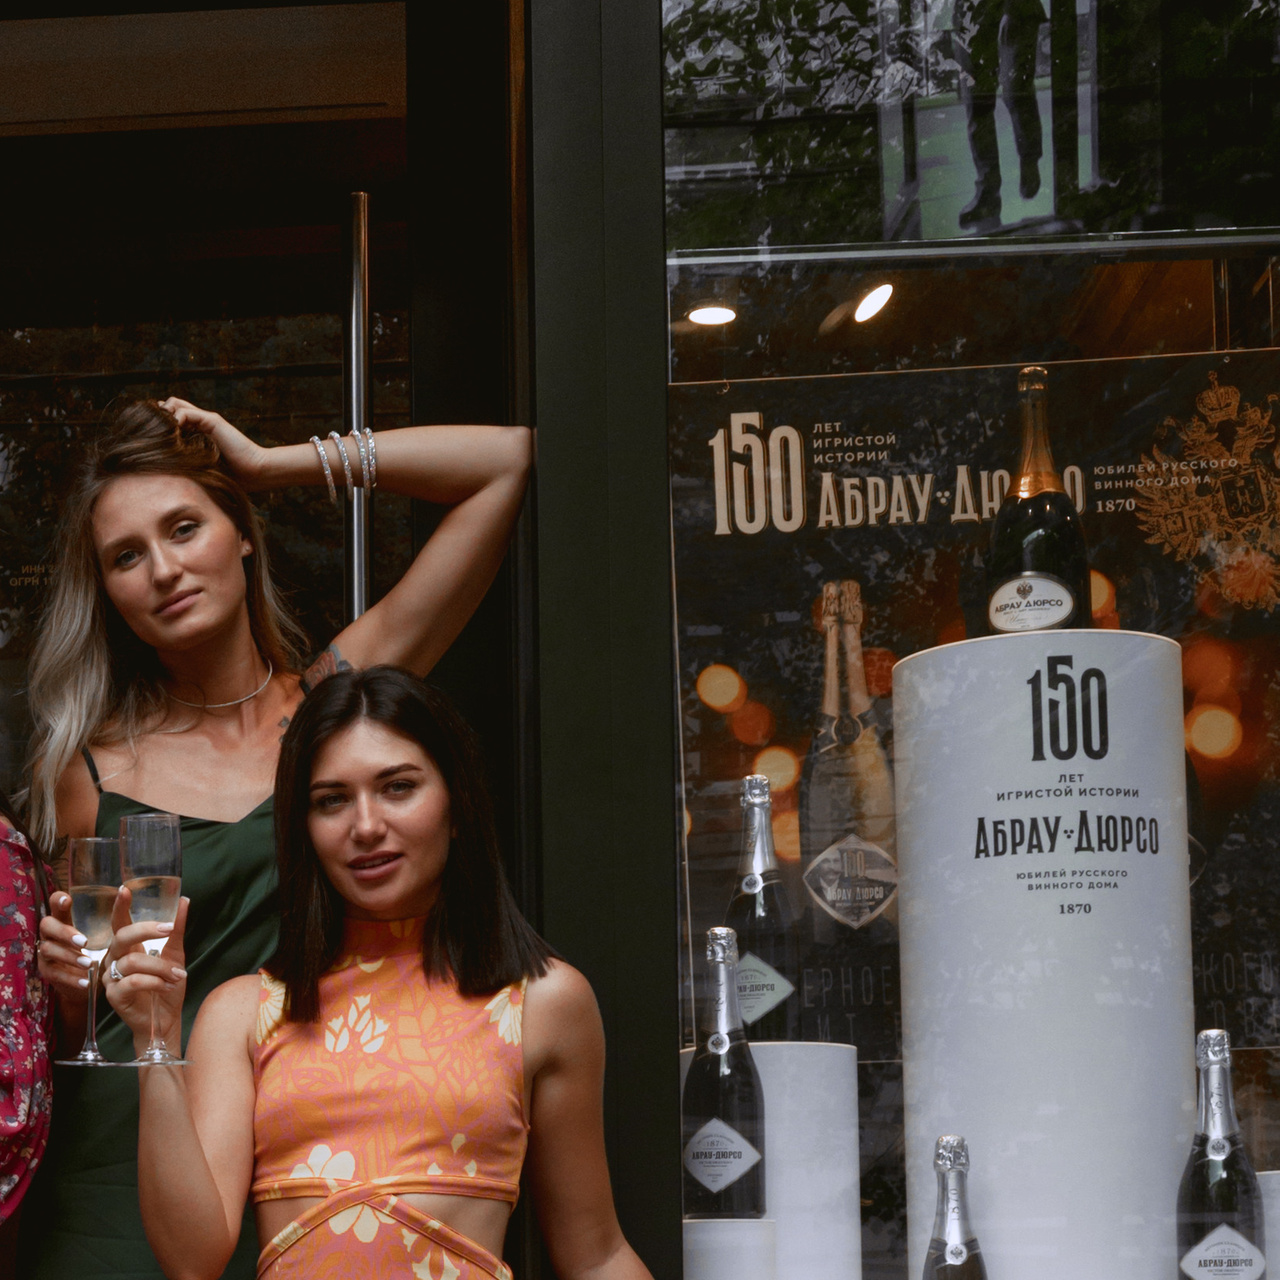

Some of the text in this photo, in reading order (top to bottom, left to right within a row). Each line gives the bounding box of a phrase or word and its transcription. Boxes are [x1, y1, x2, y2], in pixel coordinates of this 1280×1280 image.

[813, 422, 841, 433] ЛЕТ
[813, 432, 896, 448] ИГРИСТОЙ
[813, 451, 888, 464] ИСТОРИИ
[708, 412, 807, 536] 150
[1094, 458, 1238, 476] ЮБИЛЕЙ РУССКОГО
[1094, 475, 1212, 490] ВИННОГО ДОМА
[951, 464, 1086, 525] ДЮО
[1096, 499, 1136, 513] 1870
[995, 602, 1022, 614] АБРАУ
[1025, 599, 1063, 608] ДЮРСО
[1026, 655, 1109, 761] 150
[1058, 774, 1084, 783] ЛЕТ
[997, 785, 1140, 801] ИГРИСТОЙ ИСТОРИИ
[974, 810, 1159, 859] АБРАУ ДЮРСО
[1016, 868, 1128, 880] ЮБИЛЕЙ РУССКОГО
[1027, 882, 1119, 891] ВИННОГО ДОМА
[1059, 904, 1092, 914] 1870
